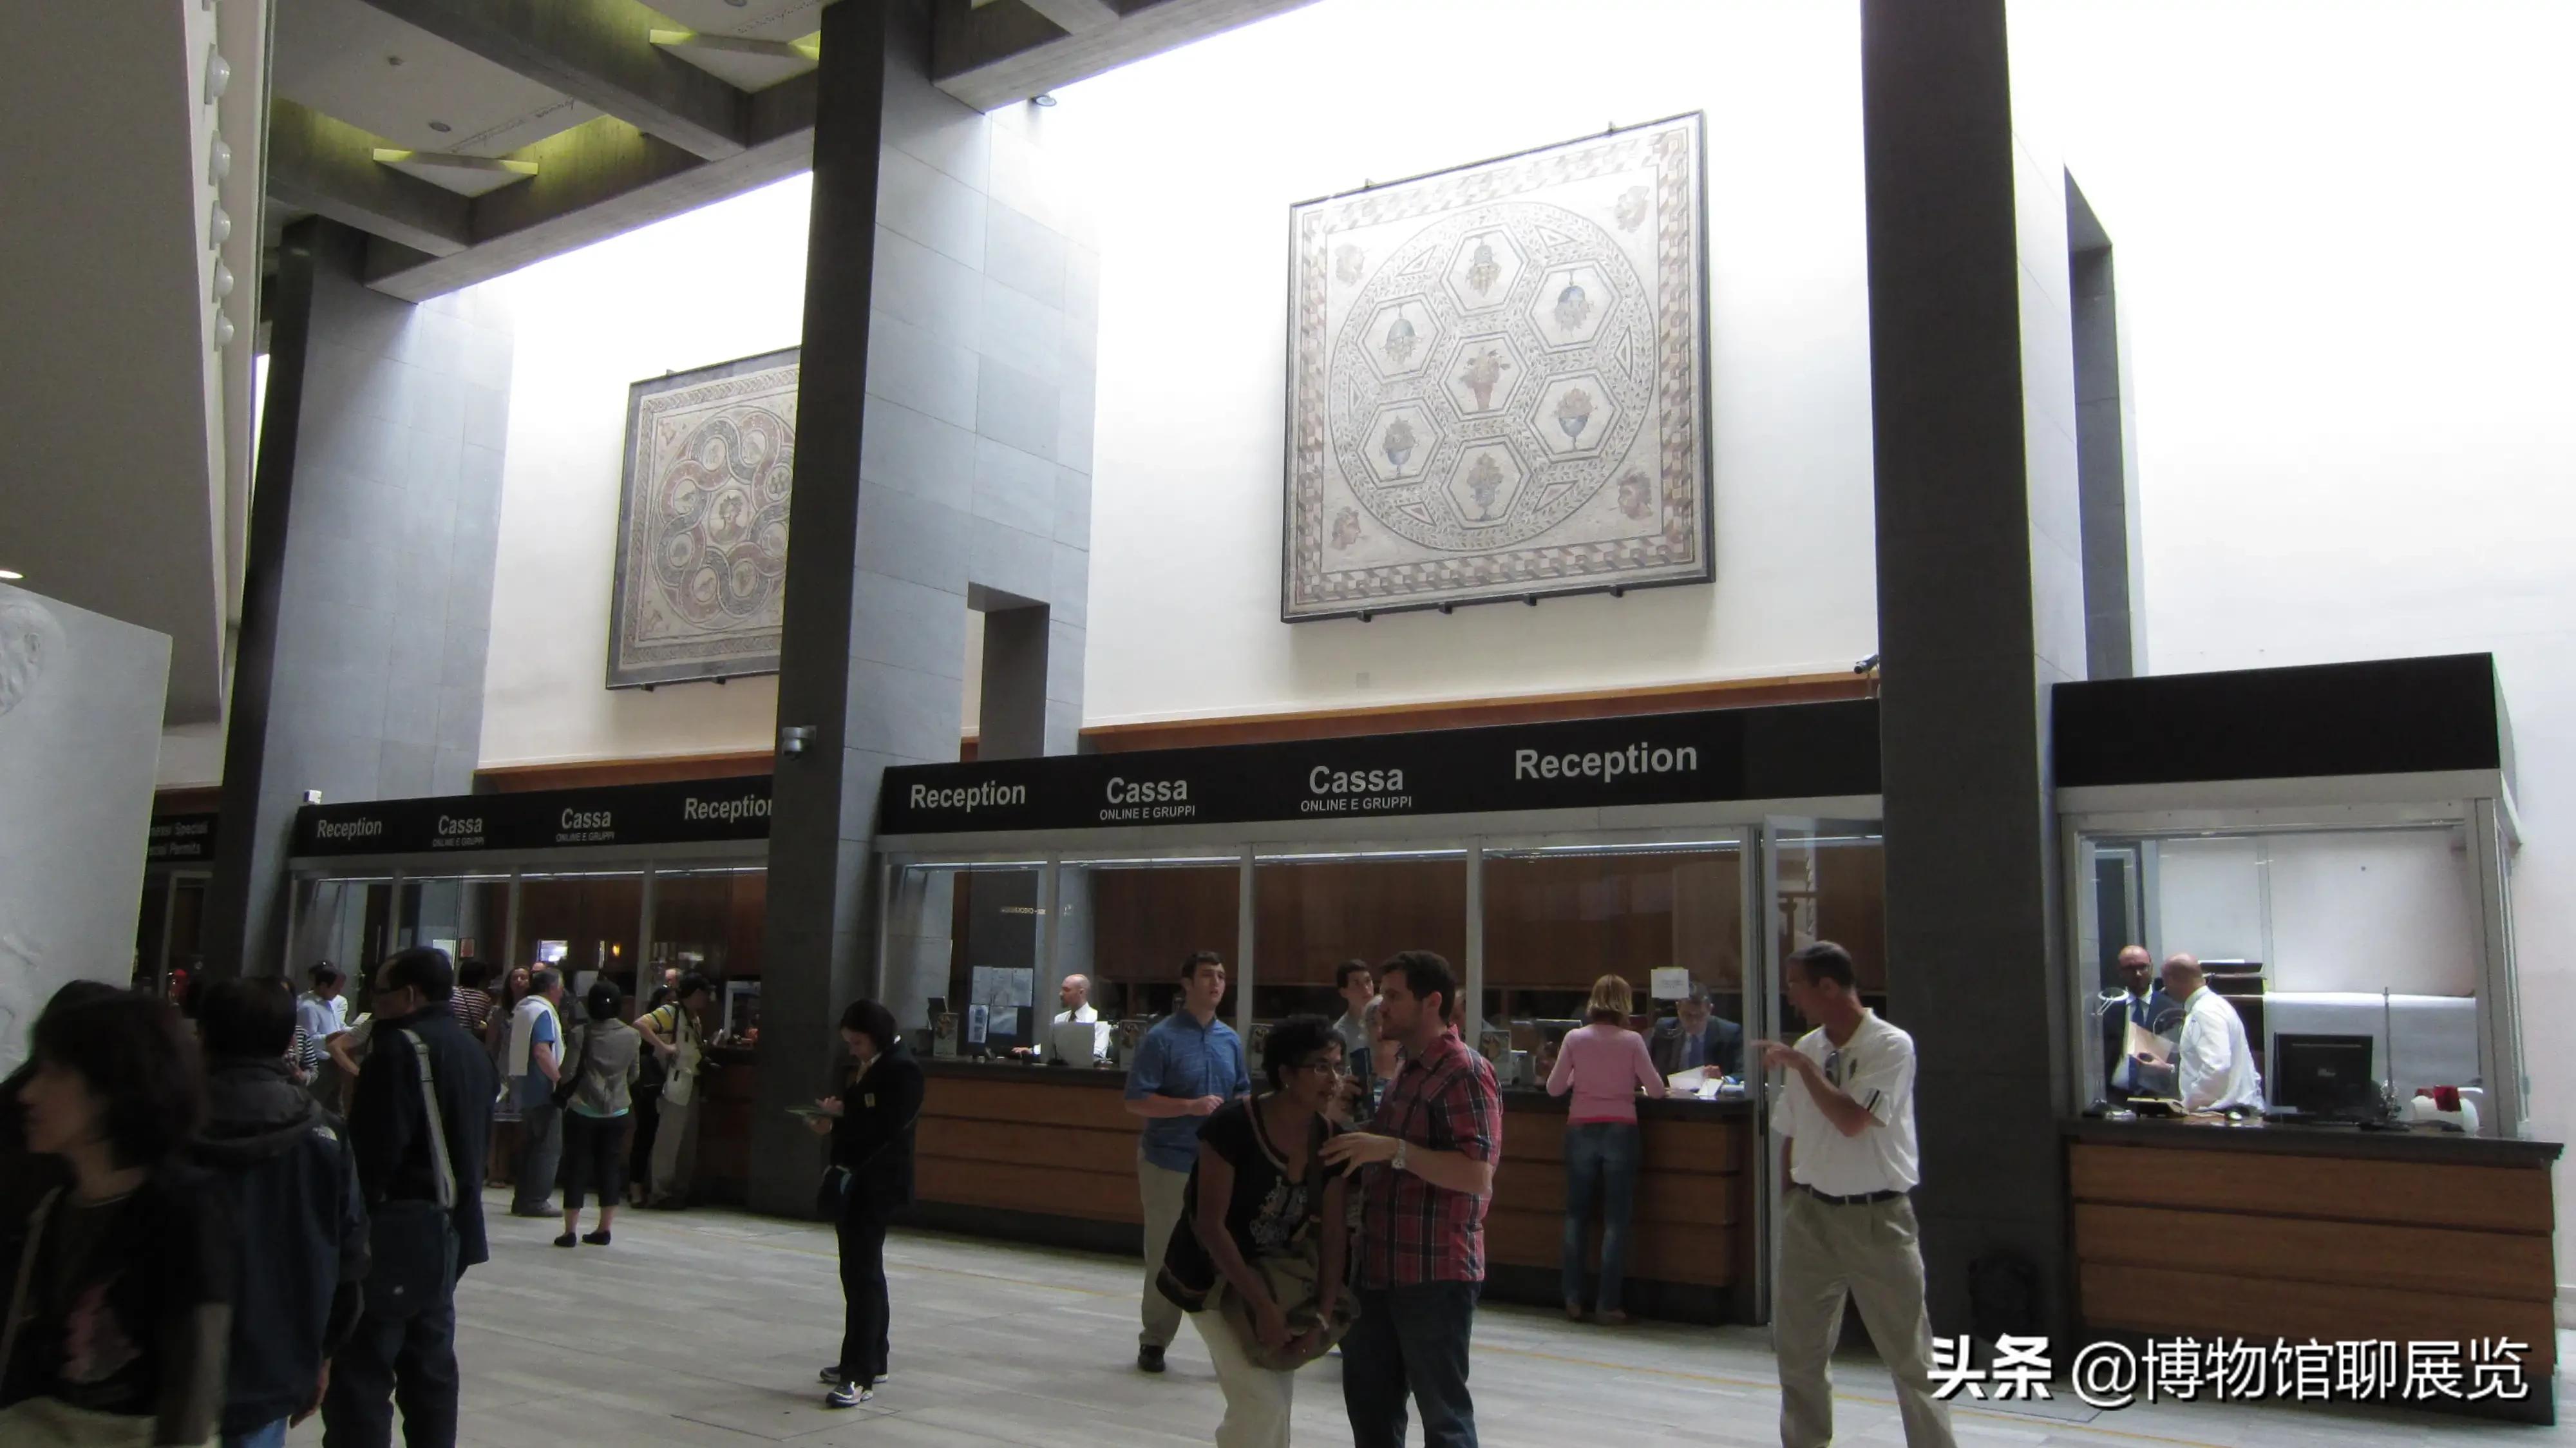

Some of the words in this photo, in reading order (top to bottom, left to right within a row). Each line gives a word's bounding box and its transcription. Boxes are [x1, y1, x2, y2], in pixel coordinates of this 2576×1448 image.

[1515, 741, 1698, 783] Reception
[1106, 777, 1188, 804] Cassa
[1309, 765, 1404, 794] Cassa
[910, 780, 1027, 813] Reception
[1300, 799, 1348, 812] ONLINE
[1351, 798, 1359, 810] E
[1363, 795, 1412, 810] GRUPPI
[438, 815, 483, 835] Cassa
[561, 808, 612, 829] Cassa
[1099, 808, 1140, 821] ONLINE
[1142, 807, 1150, 819] E
[1153, 805, 1196, 818] GRUPPI
[317, 817, 383, 841] Reception
